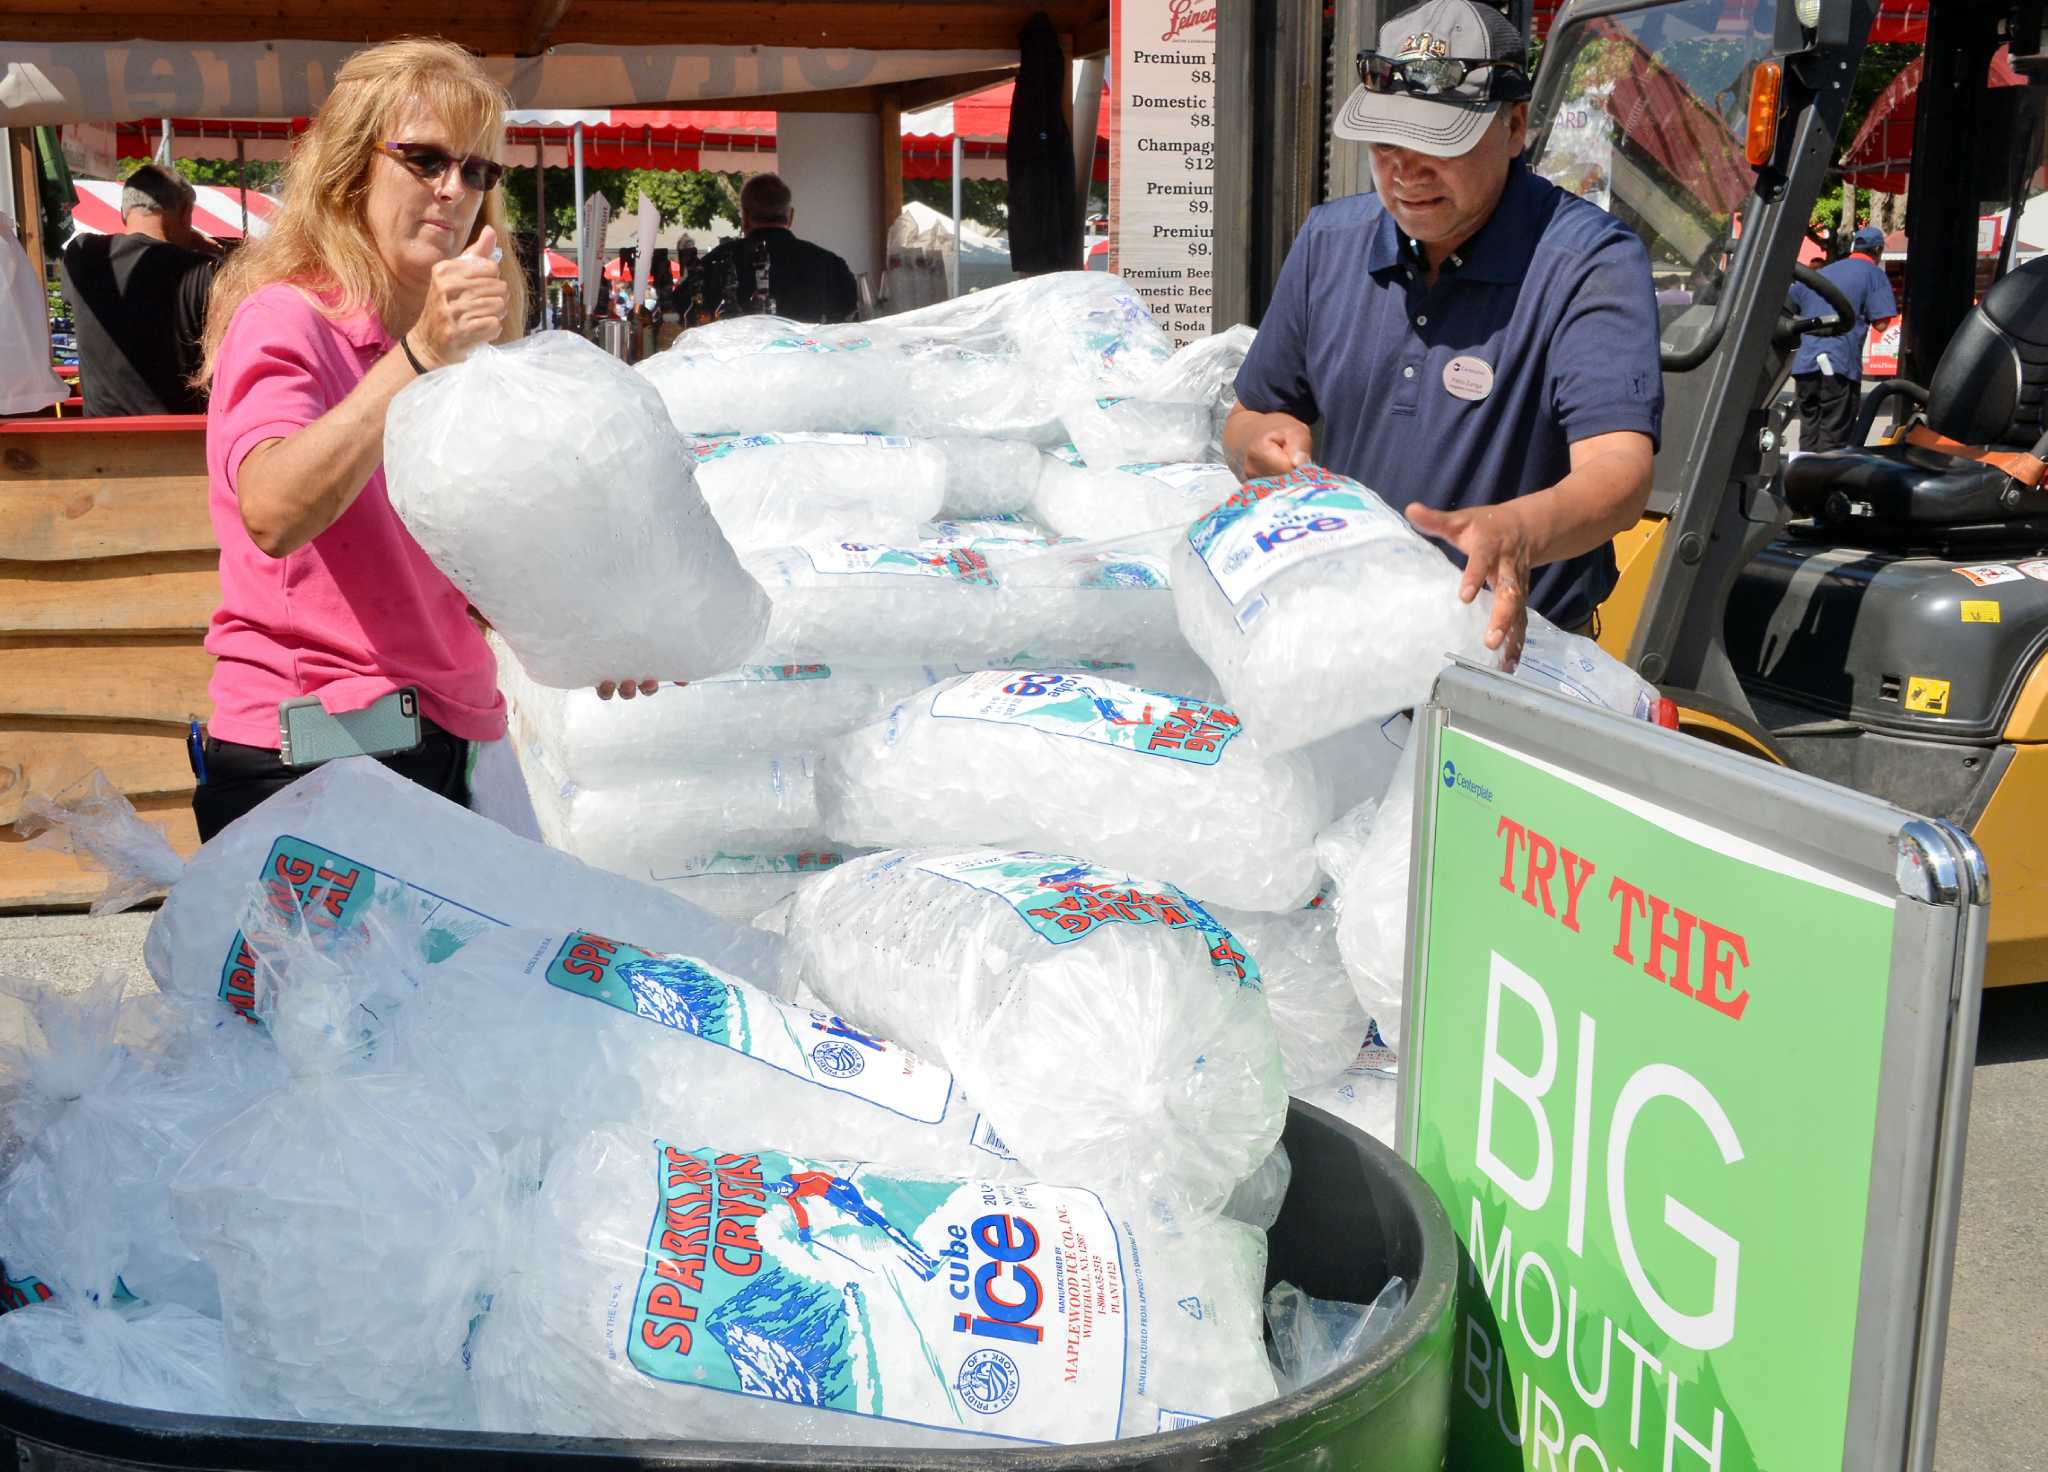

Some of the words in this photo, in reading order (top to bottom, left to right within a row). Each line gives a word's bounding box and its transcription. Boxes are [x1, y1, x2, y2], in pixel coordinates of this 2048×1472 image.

[1134, 51, 1206, 65] Premium
[1132, 95, 1207, 109] Domestic
[1123, 267, 1182, 278] Premium
[1187, 268, 1214, 278] Bee
[1136, 285, 1184, 296] mestic
[1175, 303, 1212, 313] Water
[1174, 321, 1205, 331] Soda
[1496, 815, 1596, 933] TRY
[1608, 876, 1751, 1022] THE
[1475, 949, 1745, 1351] BIG
[983, 1194, 997, 1206] 20
[641, 1146, 714, 1356] SPARKLNG
[939, 1224, 970, 1300] cube
[1065, 1250, 1079, 1275] ICE
[953, 1213, 1044, 1345] ice
[1056, 1255, 1065, 1313] MANUFACTURED
[1109, 1281, 1120, 1314] PLANT
[1139, 1305, 1148, 1328] FROM
[1064, 1276, 1081, 1383] MAPLEWOOD
[1467, 1196, 1724, 1472] MOUTH
[967, 1355, 978, 1367] OF
[991, 1352, 1014, 1376] YORK
[963, 1390, 989, 1411] PRIDE
[1001, 1380, 1016, 1405] NEW
[1463, 1313, 1627, 1472] BUR
